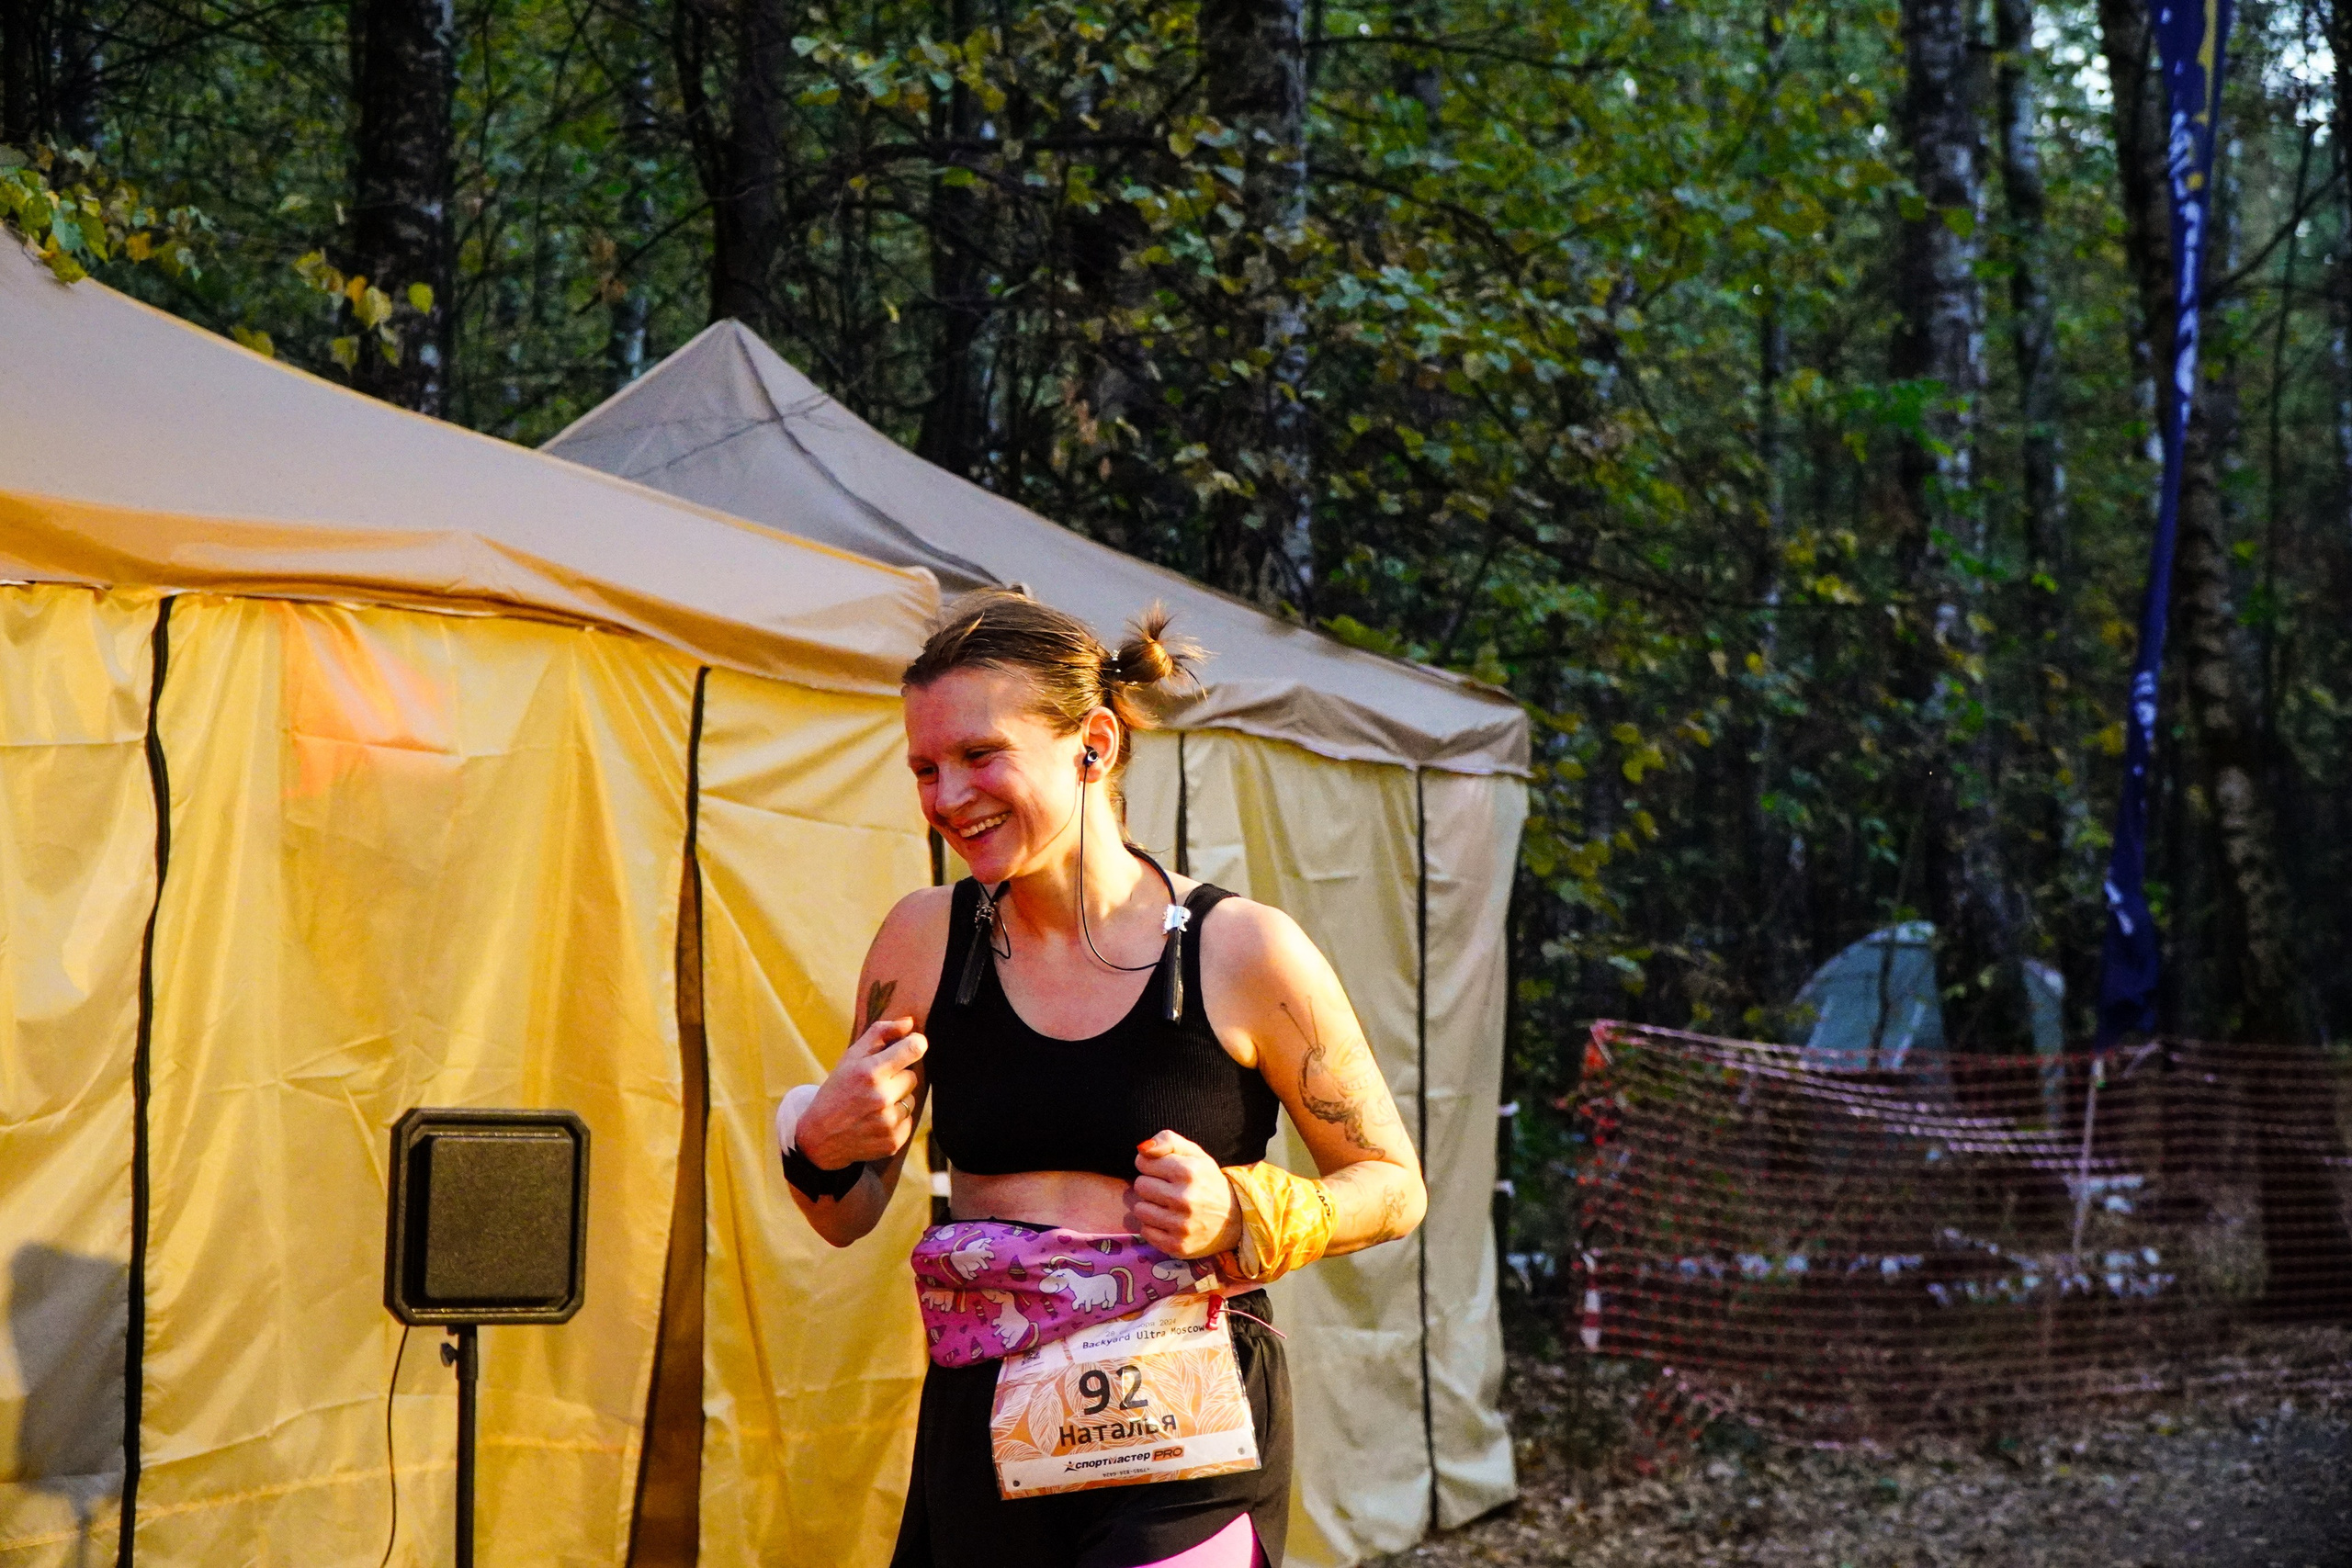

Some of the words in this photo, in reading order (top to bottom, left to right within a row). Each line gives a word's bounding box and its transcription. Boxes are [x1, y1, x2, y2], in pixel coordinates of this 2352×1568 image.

[1159, 1318, 1177, 1326] 2024
[1082, 1334, 1130, 1349] Backyard
[1136, 1330, 1166, 1340] Ultra
[1170, 1325, 1205, 1336] Moscow
[1079, 1365, 1148, 1416] 92
[1059, 1414, 1177, 1447] Наталья
[1153, 1447, 1183, 1461] PRO
